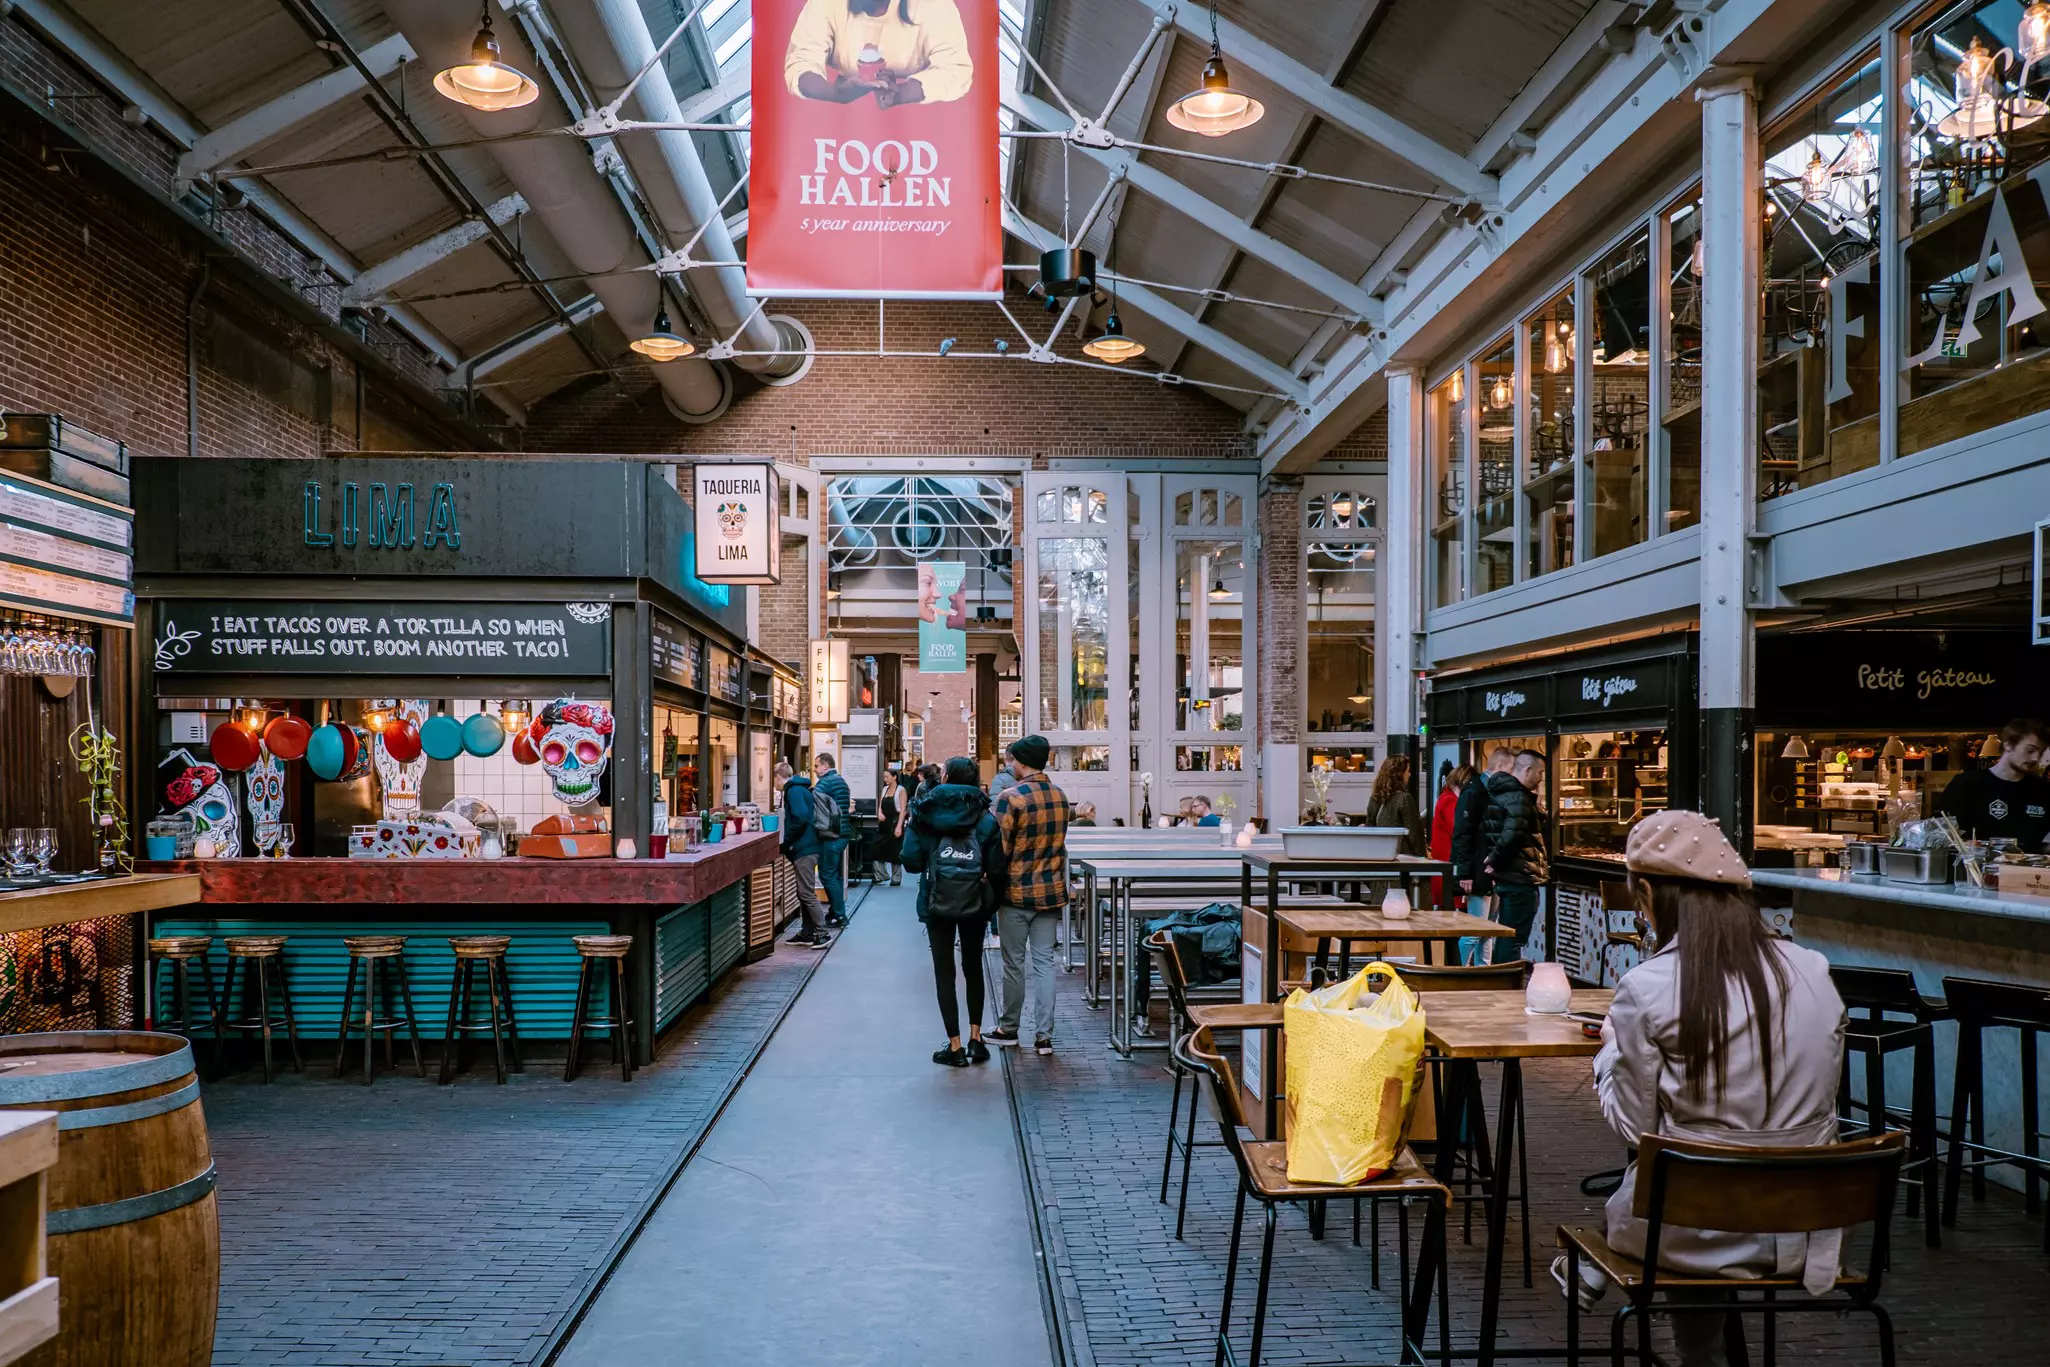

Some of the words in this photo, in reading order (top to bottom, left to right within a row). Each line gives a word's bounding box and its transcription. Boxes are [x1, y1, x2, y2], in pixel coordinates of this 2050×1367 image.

[814, 138, 938, 175] FOOD
[800, 175, 951, 207] HALLEN
[800, 218, 810, 230] 5
[809, 218, 850, 234] year
[852, 216, 951, 236] anniversary
[702, 479, 761, 495] TAQUERIA
[304, 482, 461, 548] LIMA
[718, 545, 748, 560] LIMA
[210, 616, 221, 633] I
[224, 616, 259, 633] EAT
[264, 616, 321, 634] TACOS
[325, 617, 372, 634] OVER
[376, 617, 390, 634] A
[394, 618, 485, 635] TORTILLA
[488, 618, 511, 635] SO
[515, 619, 566, 636] WHEN
[211, 638, 267, 655] STUFF
[271, 639, 325, 656] FALLS
[329, 639, 370, 656] OUT.
[373, 639, 421, 656] BOOM
[426, 640, 508, 656] ANOTHER
[513, 638, 569, 657] TACO!
[931, 643, 954, 651] FOOD
[816, 648, 824, 714] FENTO
[1581, 677, 1602, 700] Petit
[1858, 664, 1905, 690] Petit
[1917, 668, 1995, 699] gâteau
